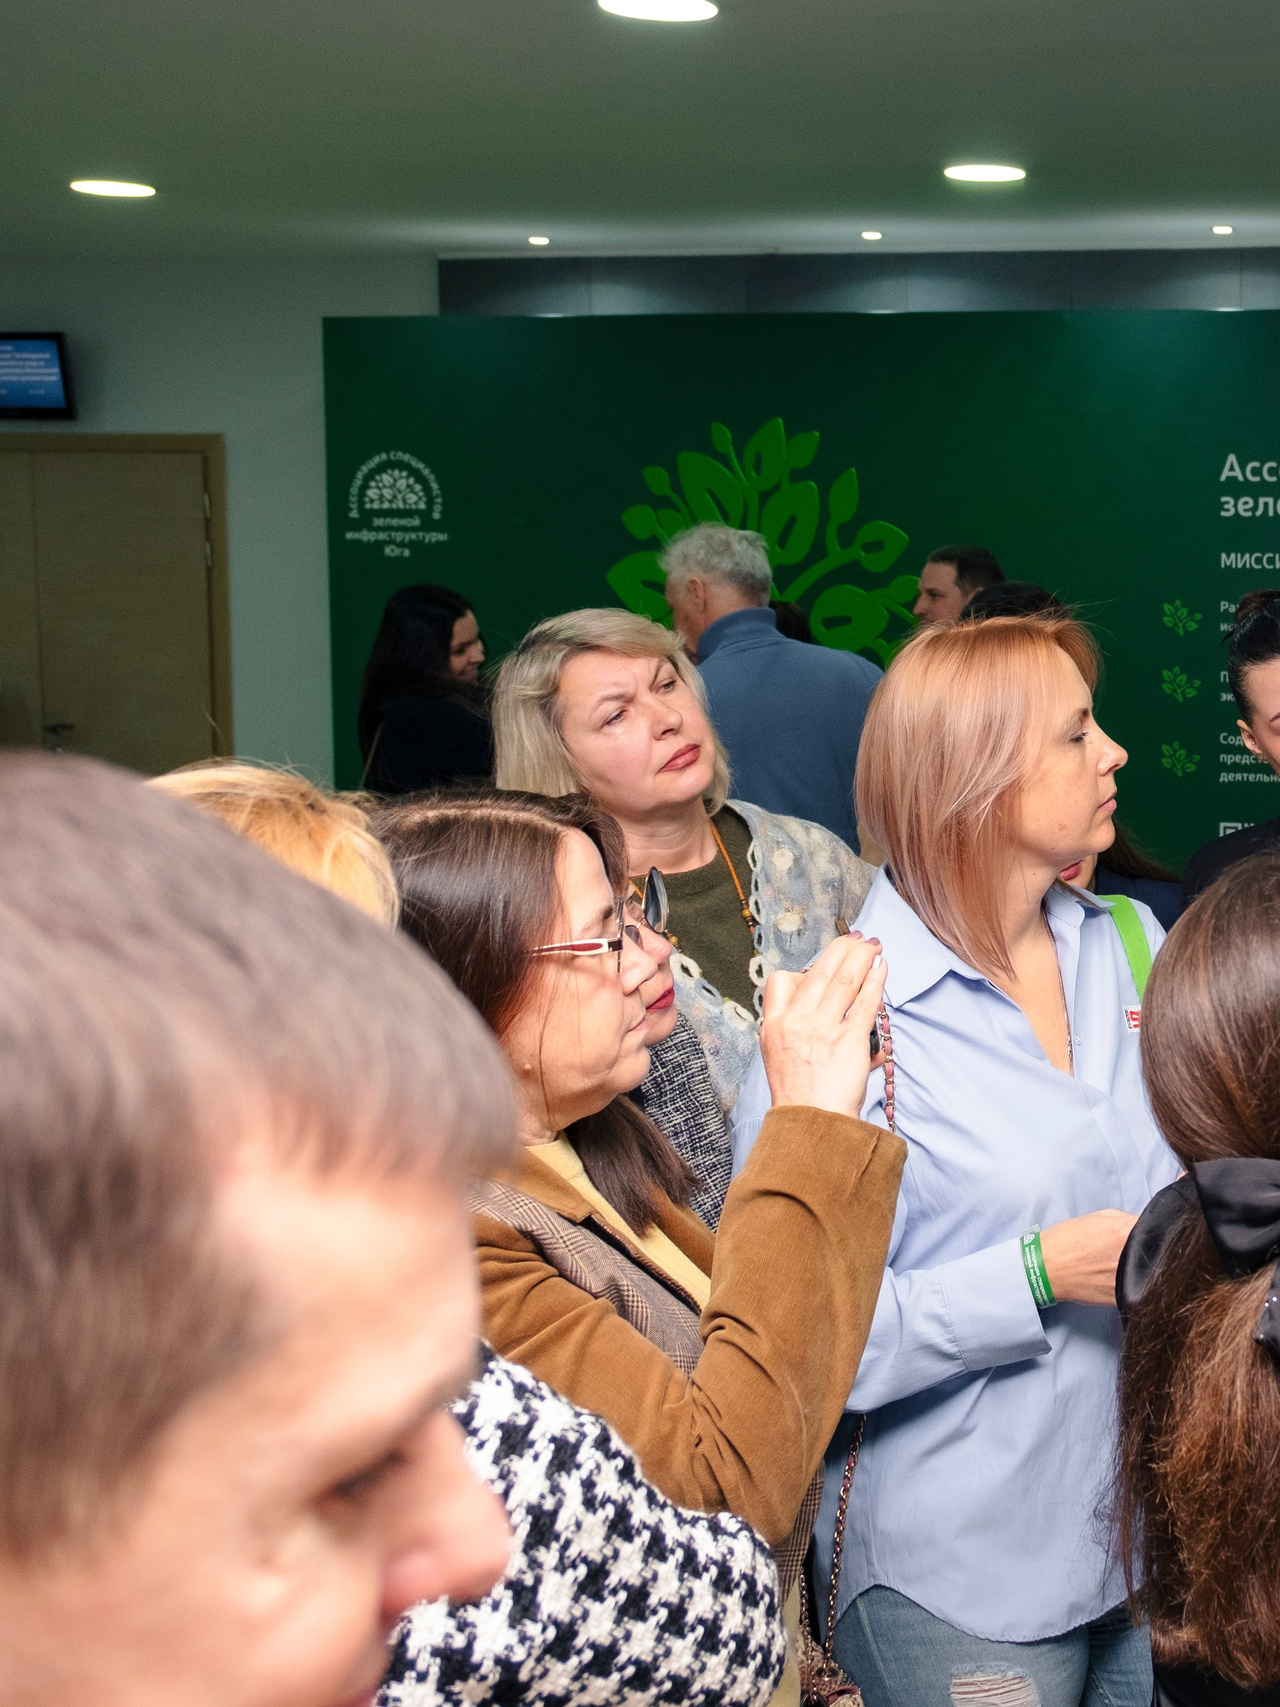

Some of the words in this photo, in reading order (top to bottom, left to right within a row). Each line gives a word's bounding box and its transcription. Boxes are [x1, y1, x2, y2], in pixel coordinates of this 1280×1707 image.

[372, 515, 421, 527] зеленой
[345, 529, 448, 543] инфраструктуры
[383, 544, 410, 557] Юга
